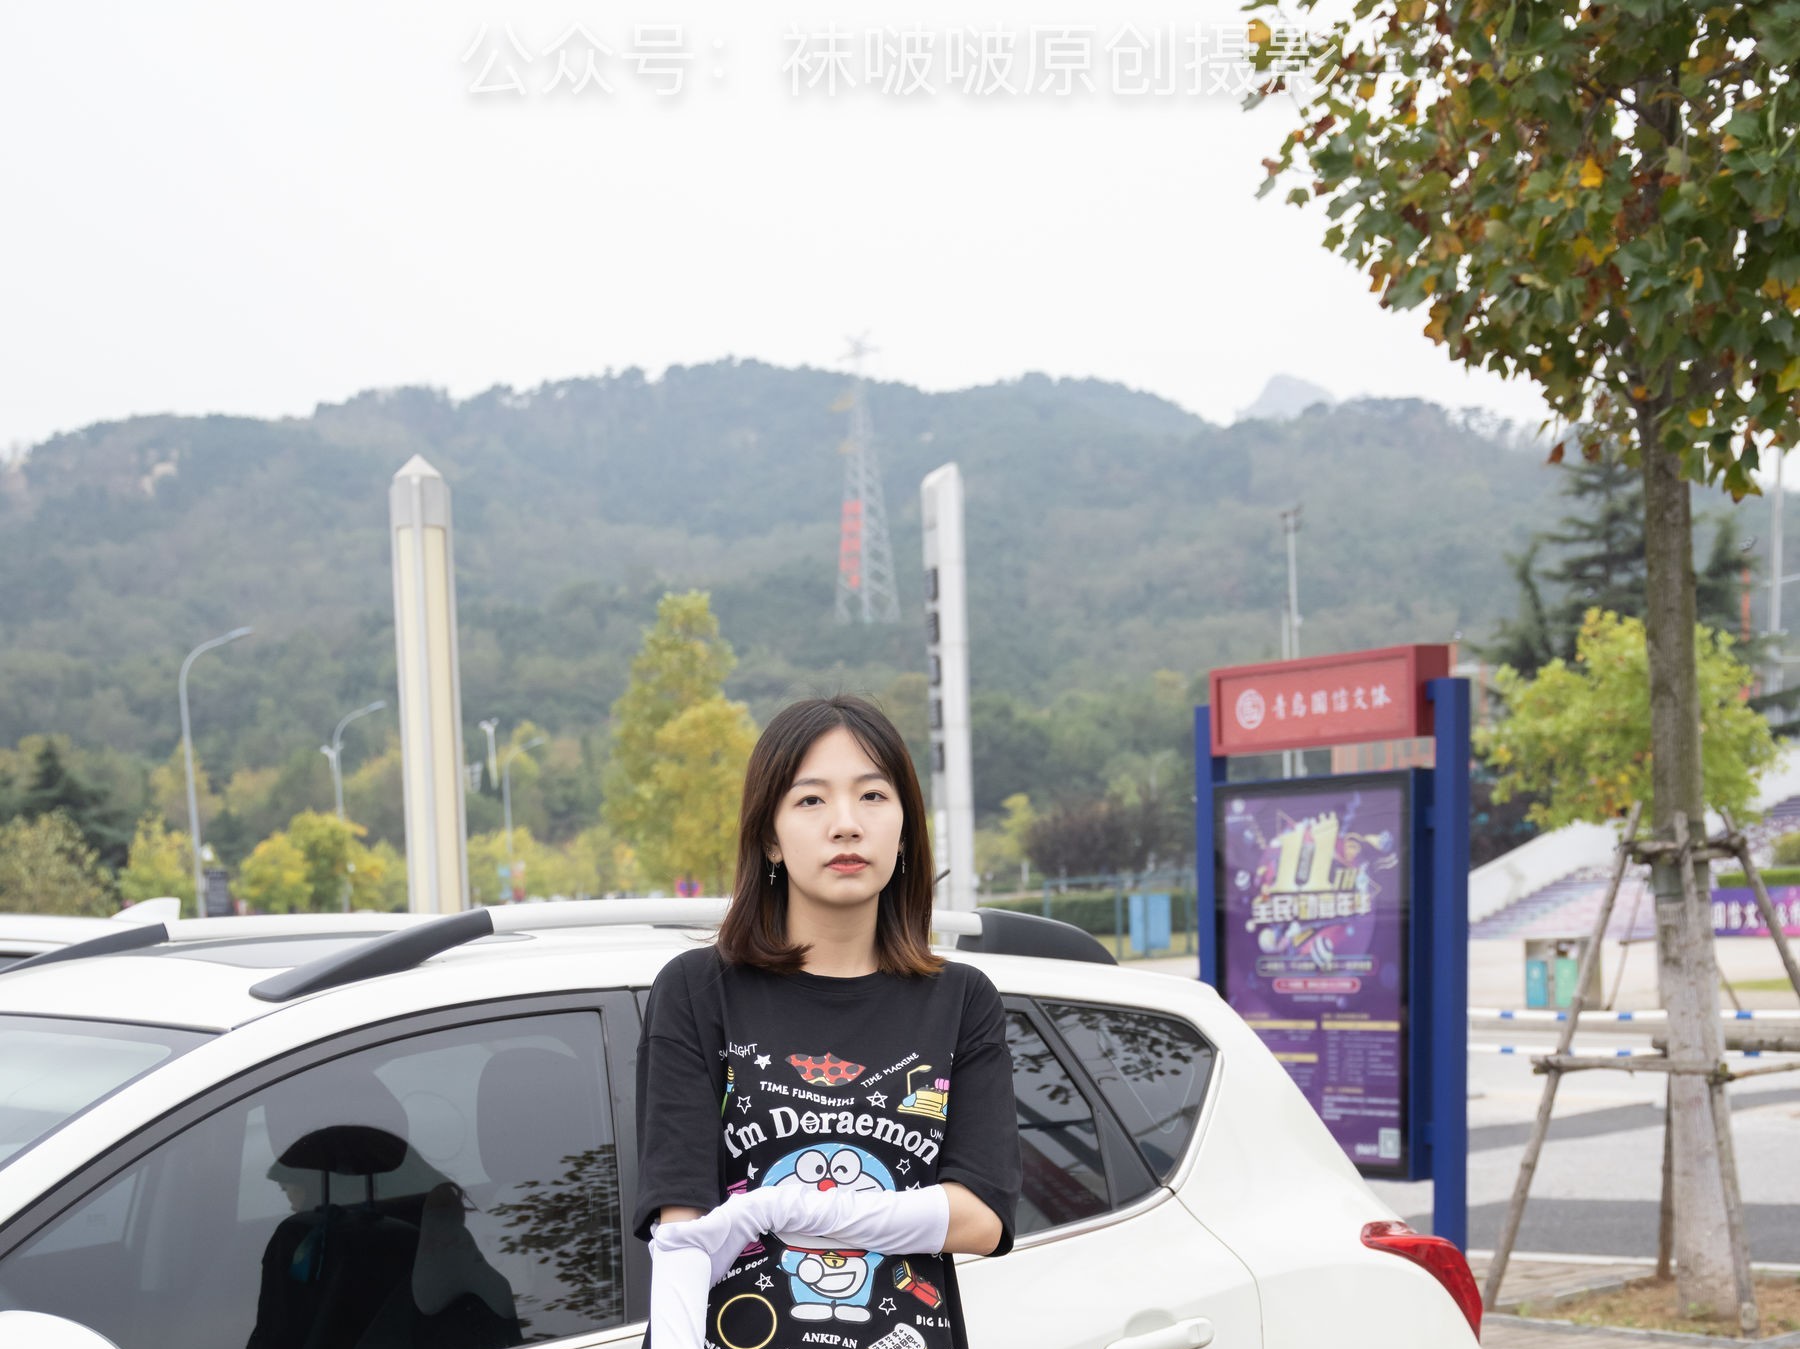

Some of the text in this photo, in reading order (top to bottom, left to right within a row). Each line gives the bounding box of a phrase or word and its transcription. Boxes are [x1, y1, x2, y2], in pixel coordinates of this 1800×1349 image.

[729, 1041, 758, 1058] LIGHT
[860, 1052, 920, 1088] TIME MACHINE
[759, 1081, 789, 1096] TIME
[724, 1106, 940, 1166] I'm Doraemon
[916, 1314, 934, 1328] BIG
